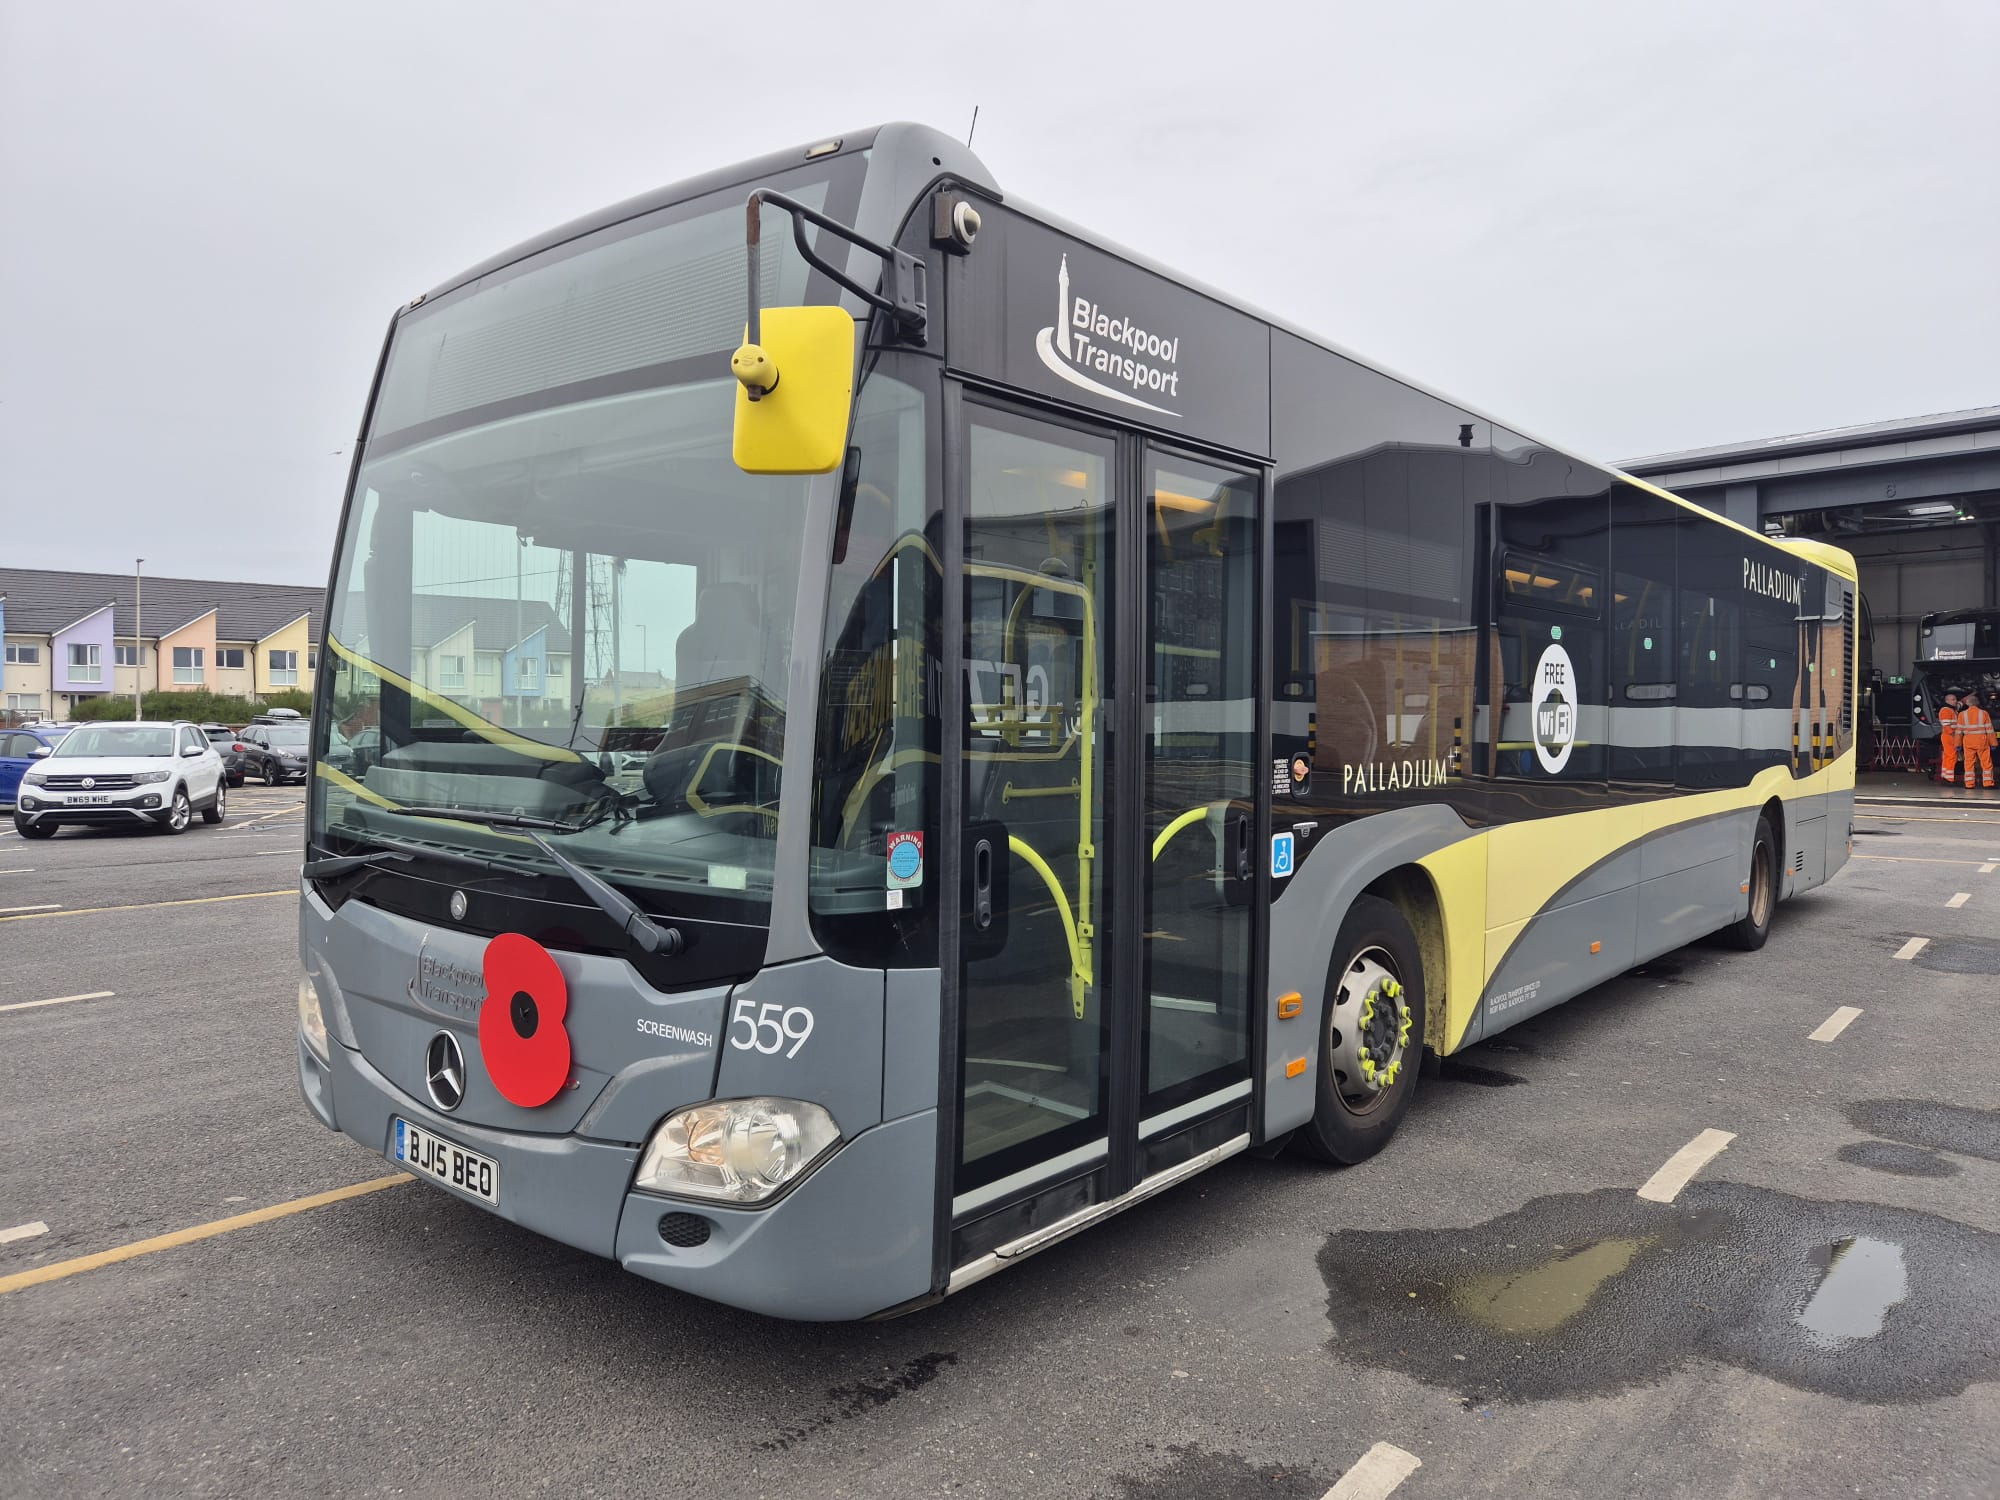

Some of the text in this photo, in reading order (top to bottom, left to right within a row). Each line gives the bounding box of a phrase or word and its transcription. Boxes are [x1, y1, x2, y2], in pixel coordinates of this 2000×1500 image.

[1072, 297, 1179, 364] Blackpool
[1073, 333, 1179, 397] Transport
[1743, 557, 1801, 606] PALLADIUM
[1544, 663, 1565, 685] FREE
[1344, 758, 1447, 795] PALLADIUM
[92, 795, 109, 804] WHE
[888, 834, 922, 850] WARNING
[423, 955, 485, 989] Blackpool
[636, 1018, 713, 1048] SCREENWASH
[730, 1000, 815, 1060] 559
[410, 1129, 492, 1197] BJ15 BEO
